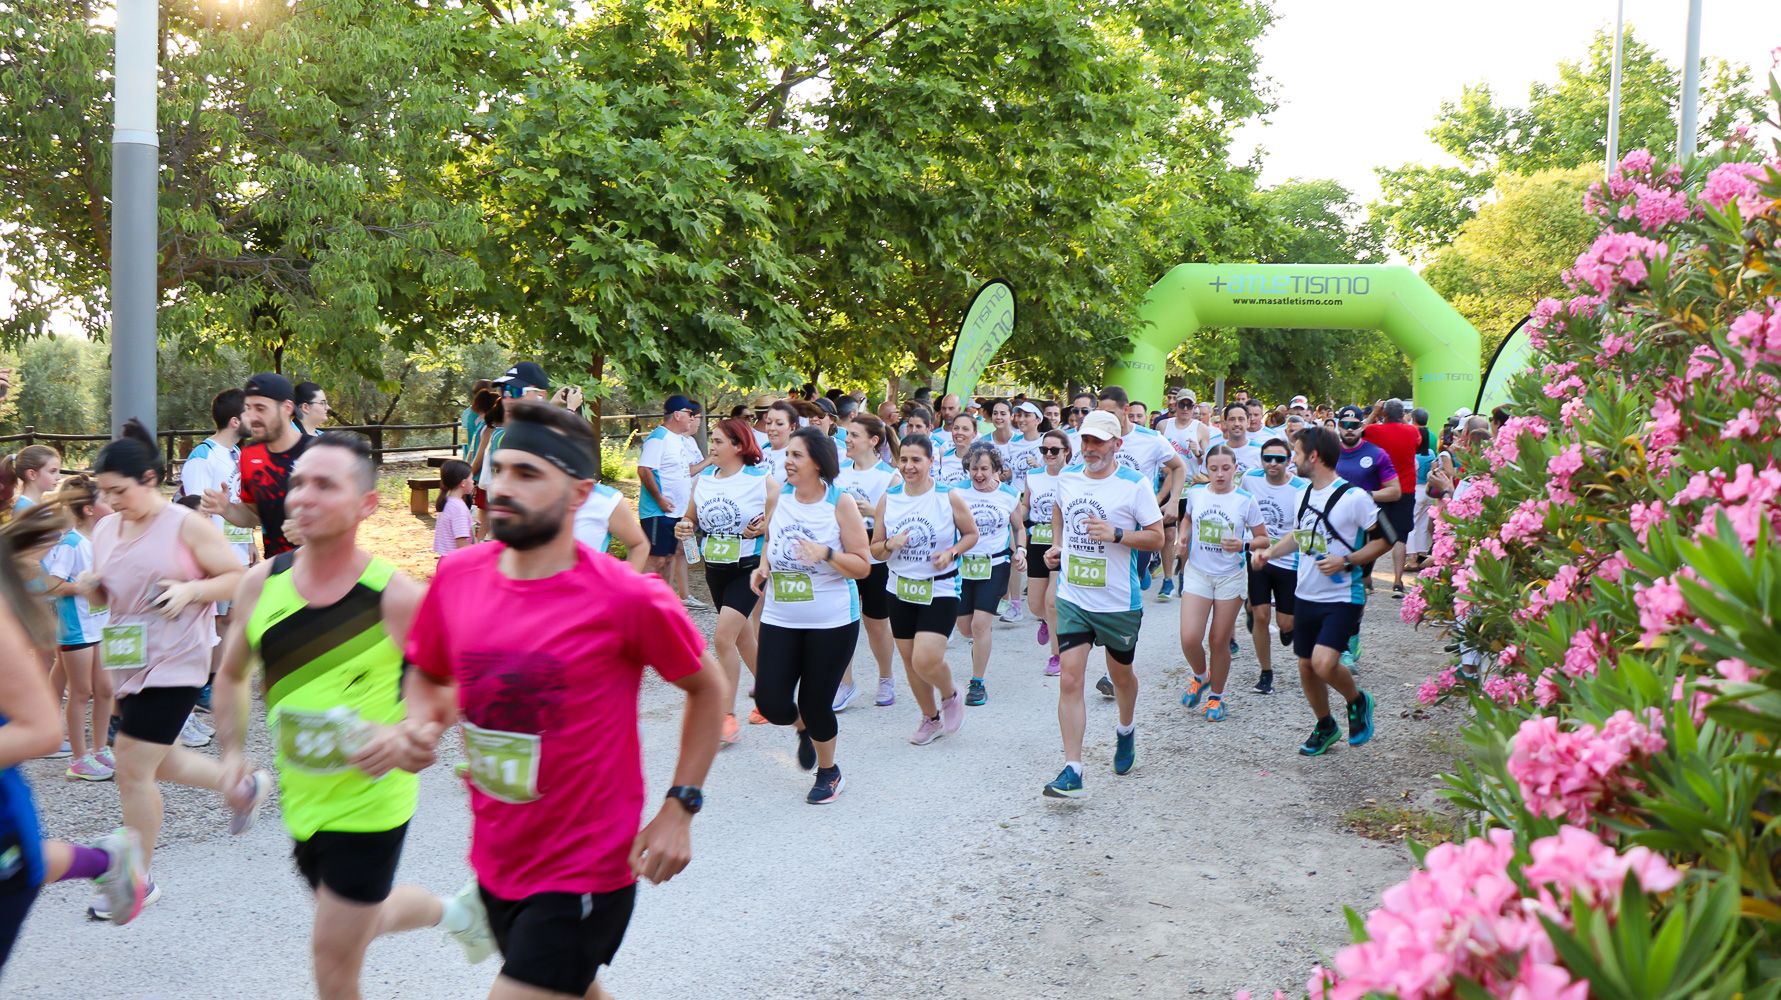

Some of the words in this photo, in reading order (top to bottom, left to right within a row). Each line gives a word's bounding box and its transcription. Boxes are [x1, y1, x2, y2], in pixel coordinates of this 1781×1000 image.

[1233, 297, 1343, 306] www.masatletismo.com
[1205, 527, 1220, 538] 21
[712, 543, 730, 554] 27
[966, 562, 987, 573] 147
[1073, 565, 1100, 580] 120
[780, 580, 807, 593] 170
[903, 582, 927, 596] 106
